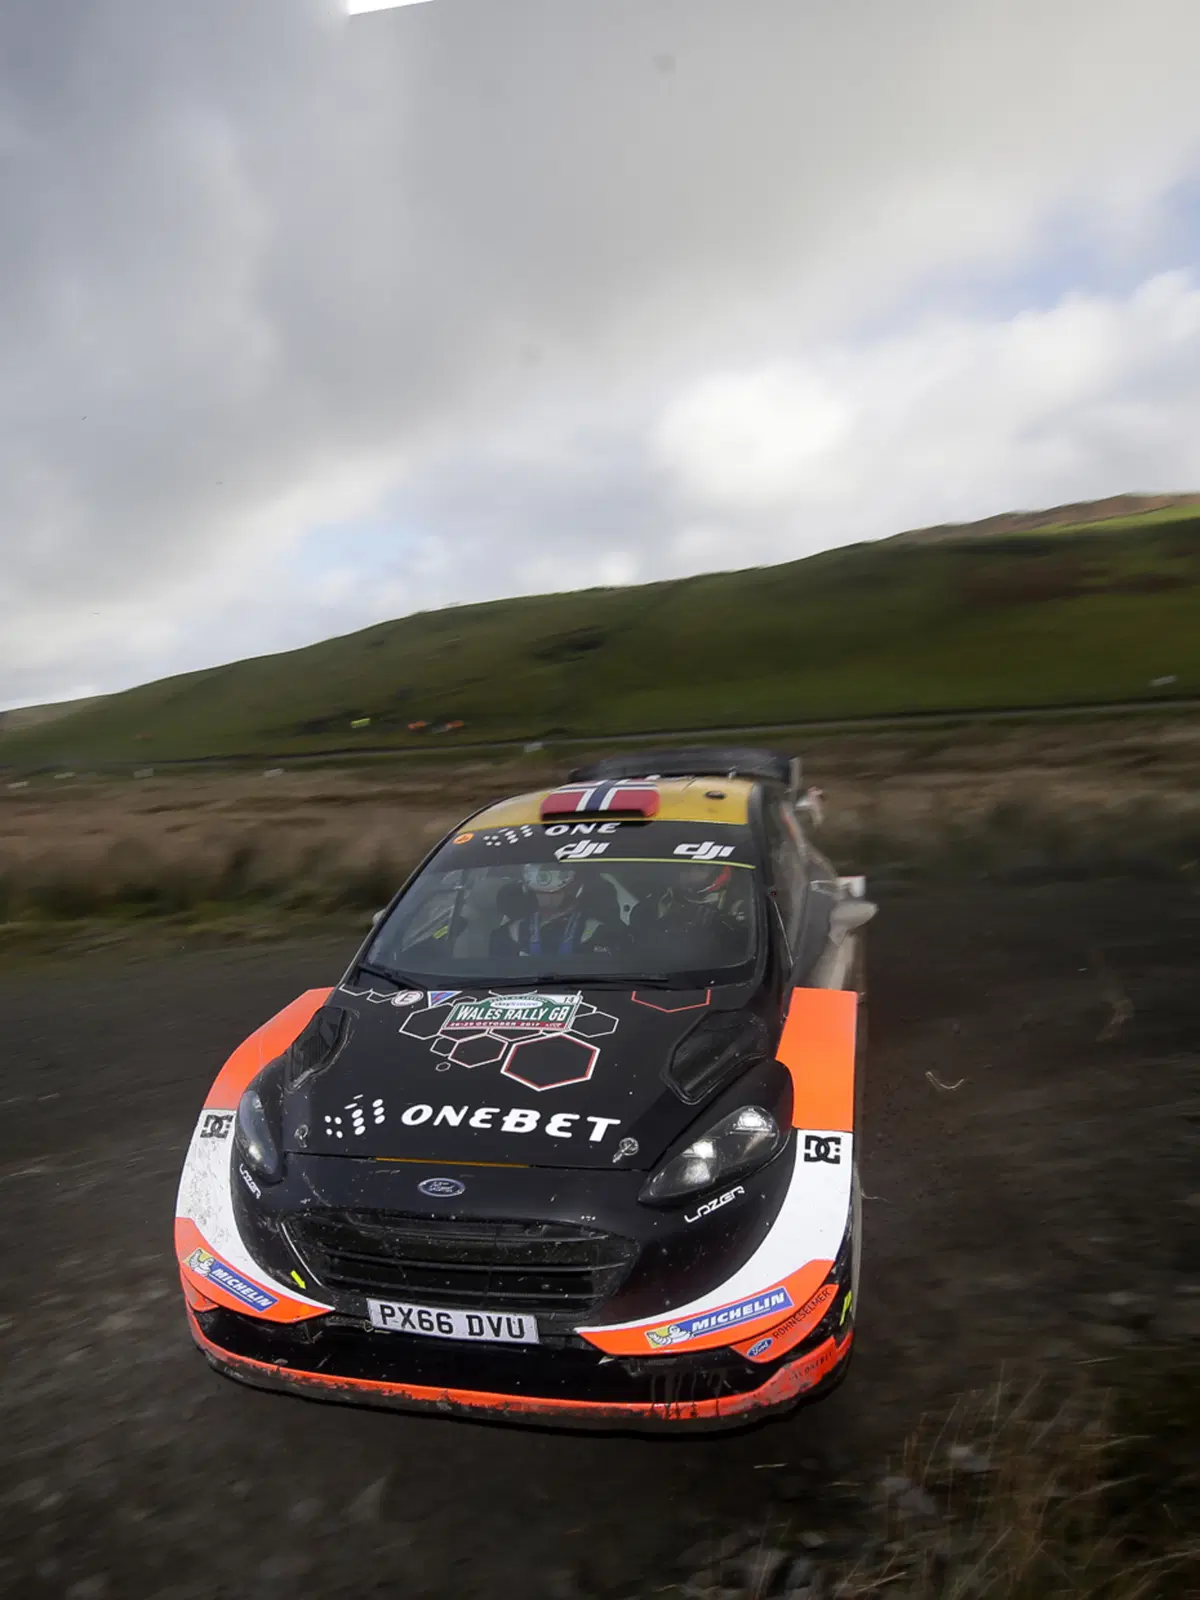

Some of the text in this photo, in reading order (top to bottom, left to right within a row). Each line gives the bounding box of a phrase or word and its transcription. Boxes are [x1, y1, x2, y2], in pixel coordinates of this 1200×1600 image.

[544, 822, 621, 836] ONE
[673, 841, 735, 860] dji
[456, 1005, 571, 1021] WALES RALLY GB
[401, 1104, 621, 1142] ONEBET
[211, 1267, 274, 1307] MICHELIN
[379, 1304, 525, 1339] PX66 DVU
[692, 1292, 785, 1332] MICHELIN
